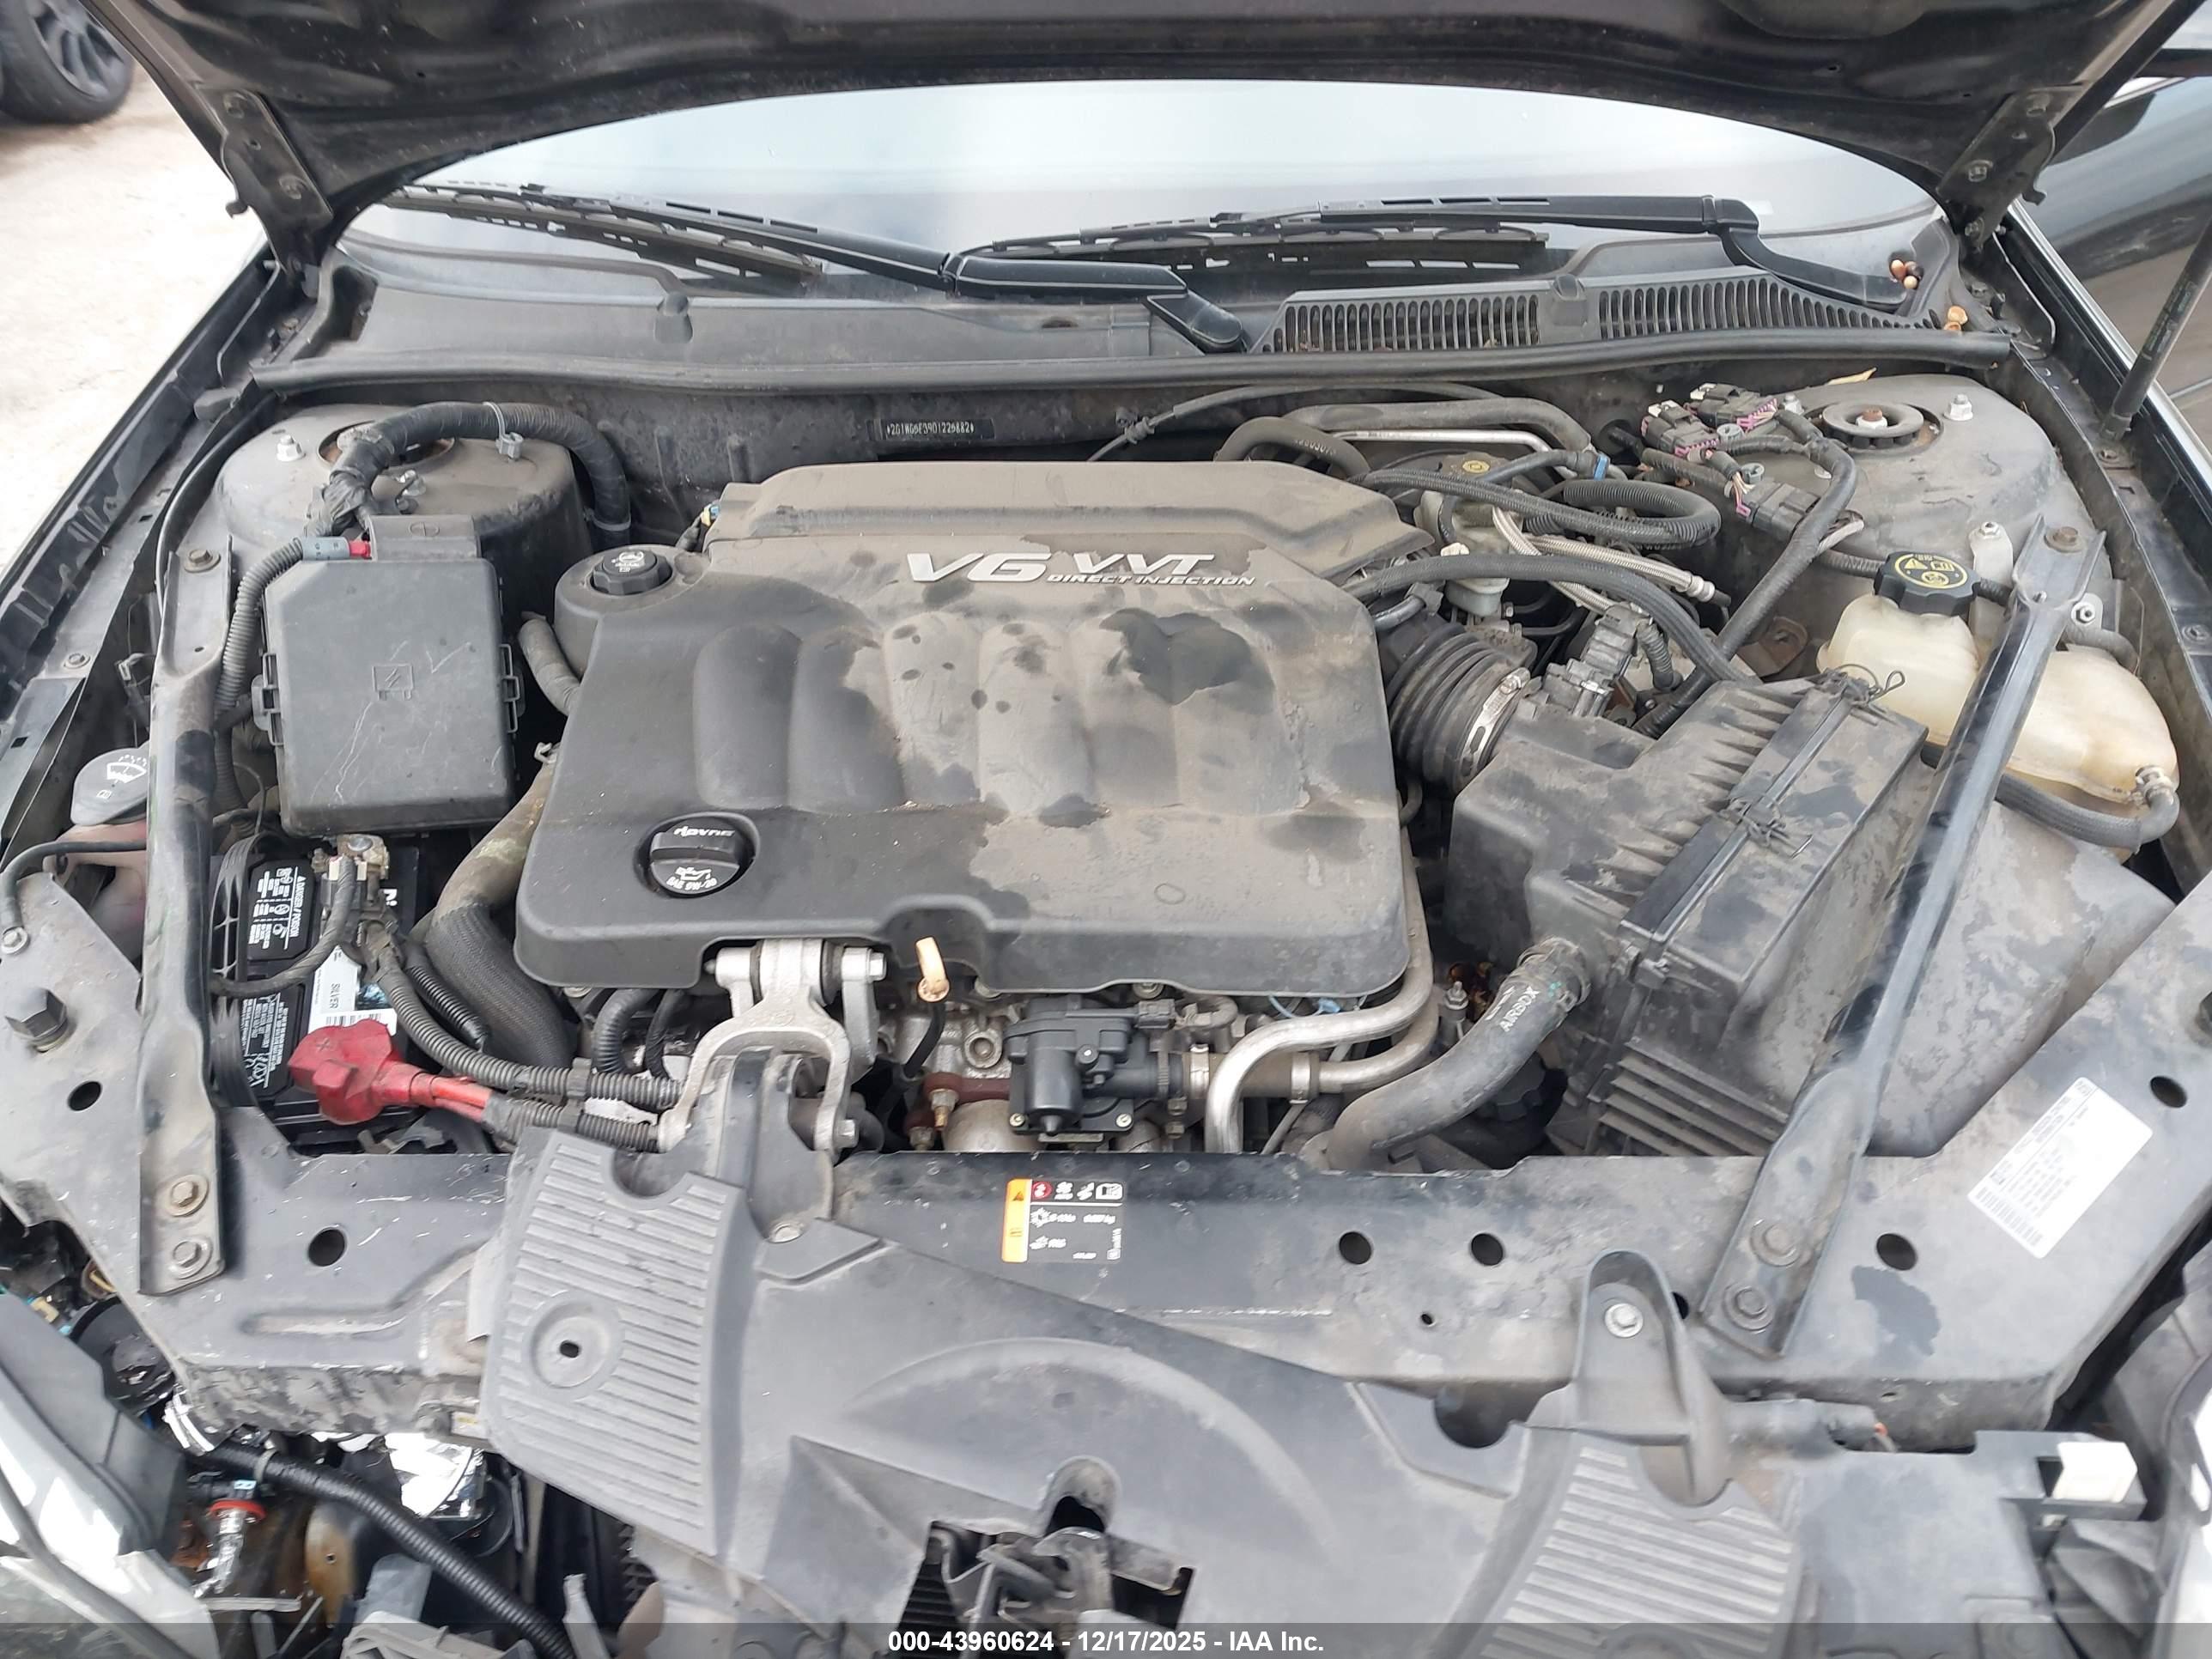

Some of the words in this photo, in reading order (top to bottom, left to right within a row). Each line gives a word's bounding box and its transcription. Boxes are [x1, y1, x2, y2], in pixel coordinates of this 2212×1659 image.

[906, 552, 1052, 582] V6
[1073, 553, 1215, 575] VVT
[1047, 574, 1133, 584] DIRECT
[1133, 575, 1255, 586] INJECTION
[329, 982, 341, 1010] SILVER
[1499, 986, 1540, 1032] AIRBOX
